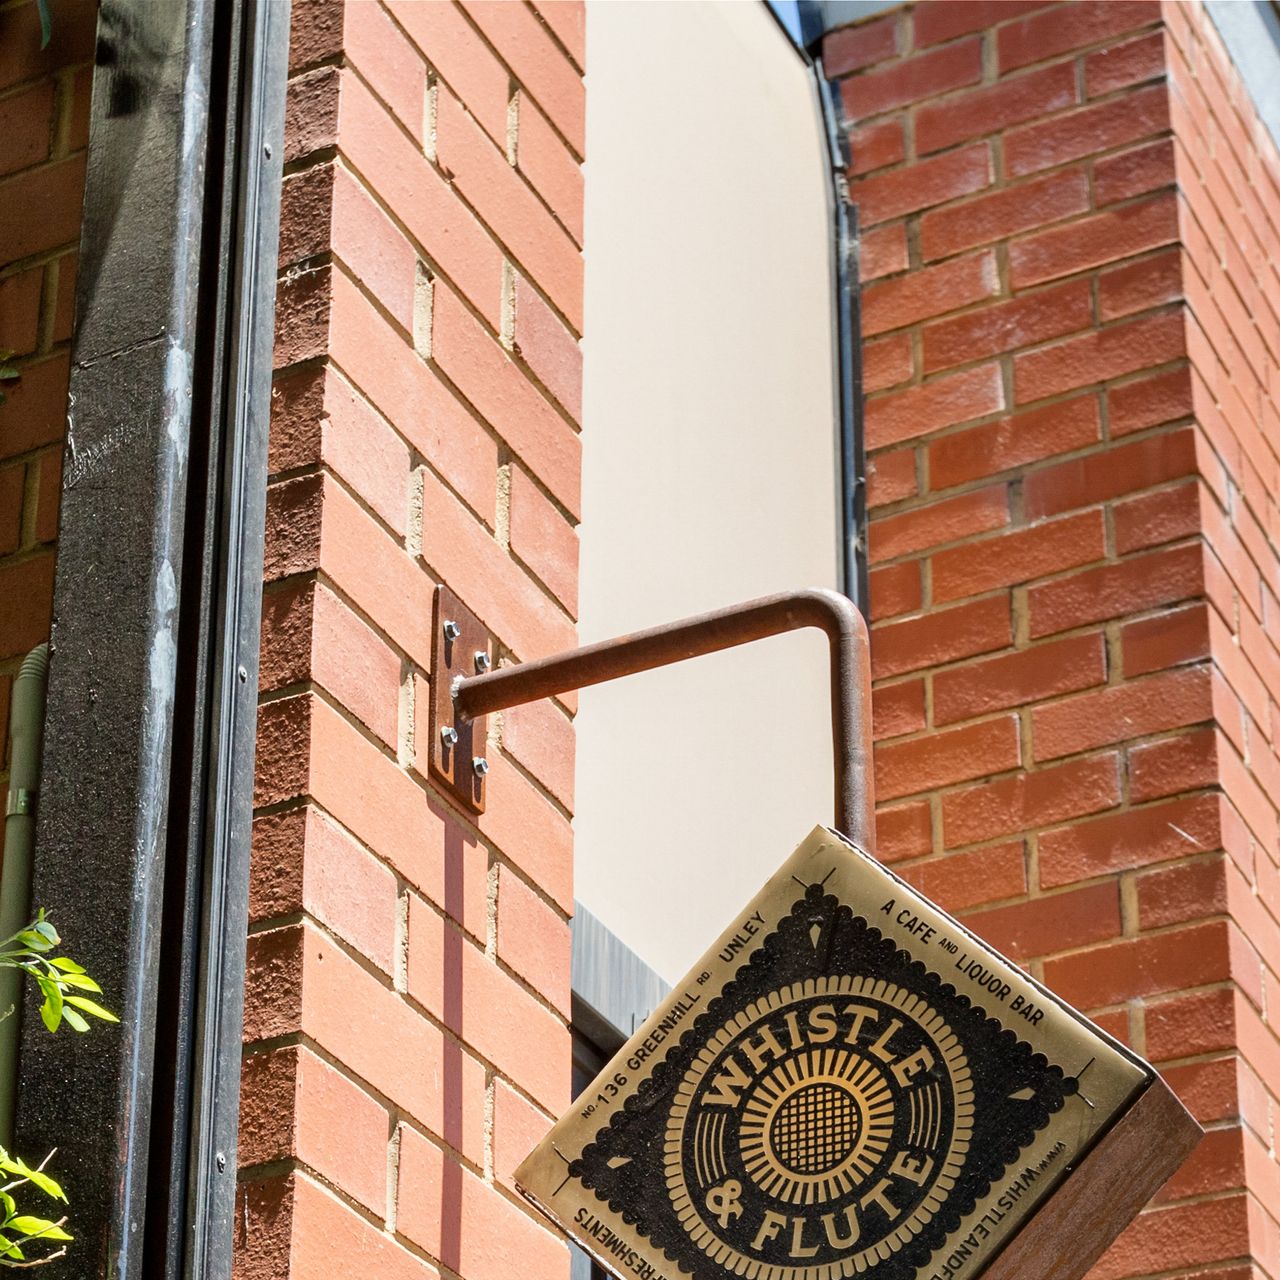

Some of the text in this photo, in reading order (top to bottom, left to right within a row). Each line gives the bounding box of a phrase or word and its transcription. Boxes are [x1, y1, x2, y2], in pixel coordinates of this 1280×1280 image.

[627, 992, 701, 1071] GREENHILL
[696, 970, 713, 986] RD.
[718, 910, 766, 963] UNLEY
[880, 899, 1045, 1026] A CAFE AND LIQUOR BAR
[701, 1003, 936, 1109] WHISTLE
[705, 1151, 935, 1258] & FLUTE
